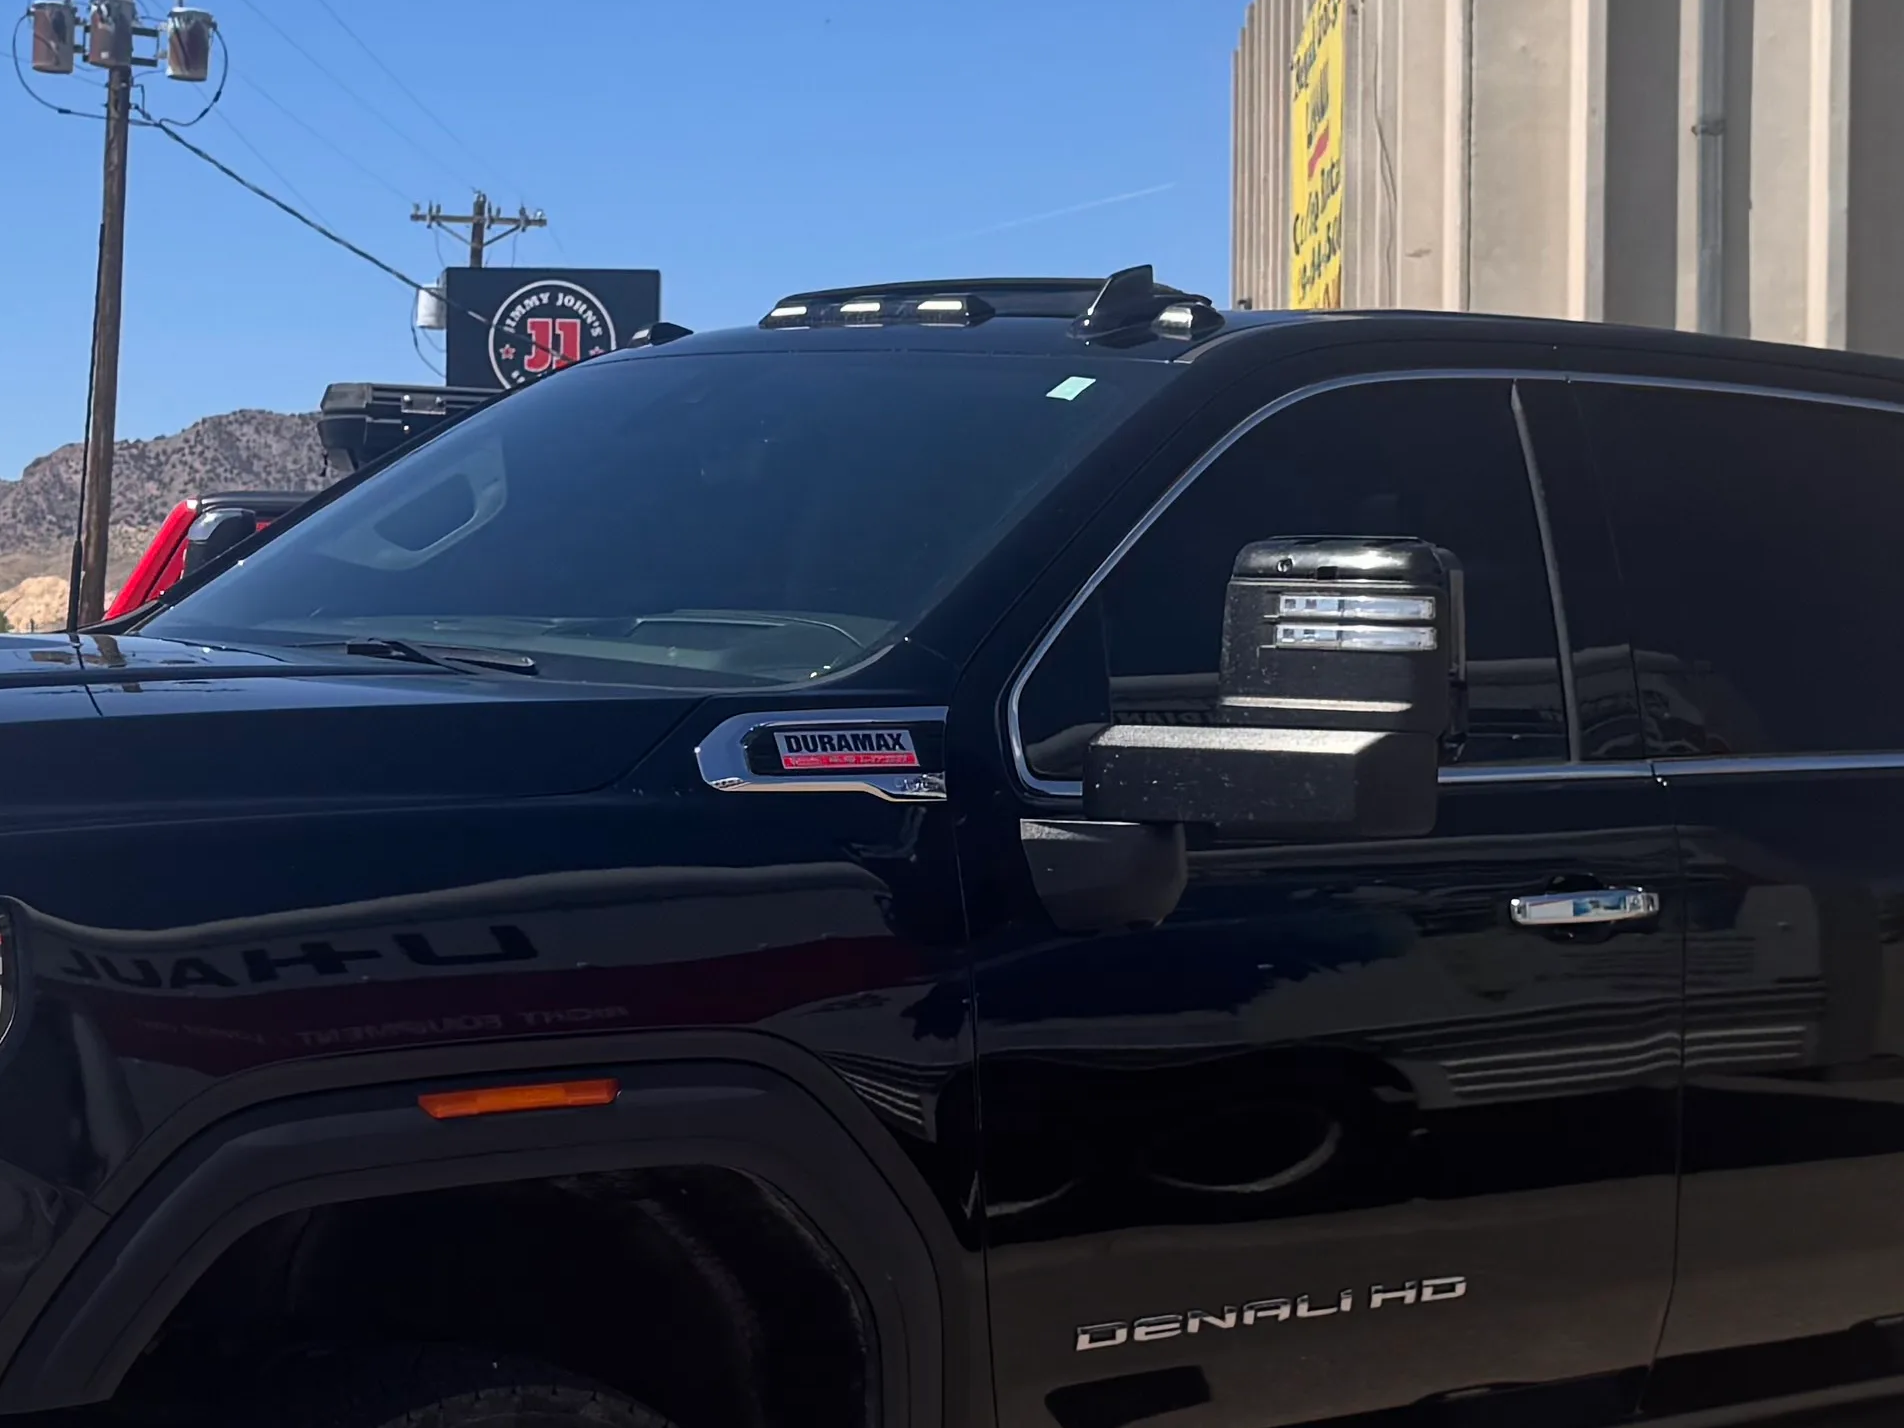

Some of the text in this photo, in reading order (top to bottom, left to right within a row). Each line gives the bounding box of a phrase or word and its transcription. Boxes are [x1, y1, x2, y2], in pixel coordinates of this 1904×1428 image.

[503, 291, 603, 337] JIMMY JOHN'S
[784, 732, 906, 754] DURAMAX
[1075, 1276, 1467, 1352] DENALI HD
